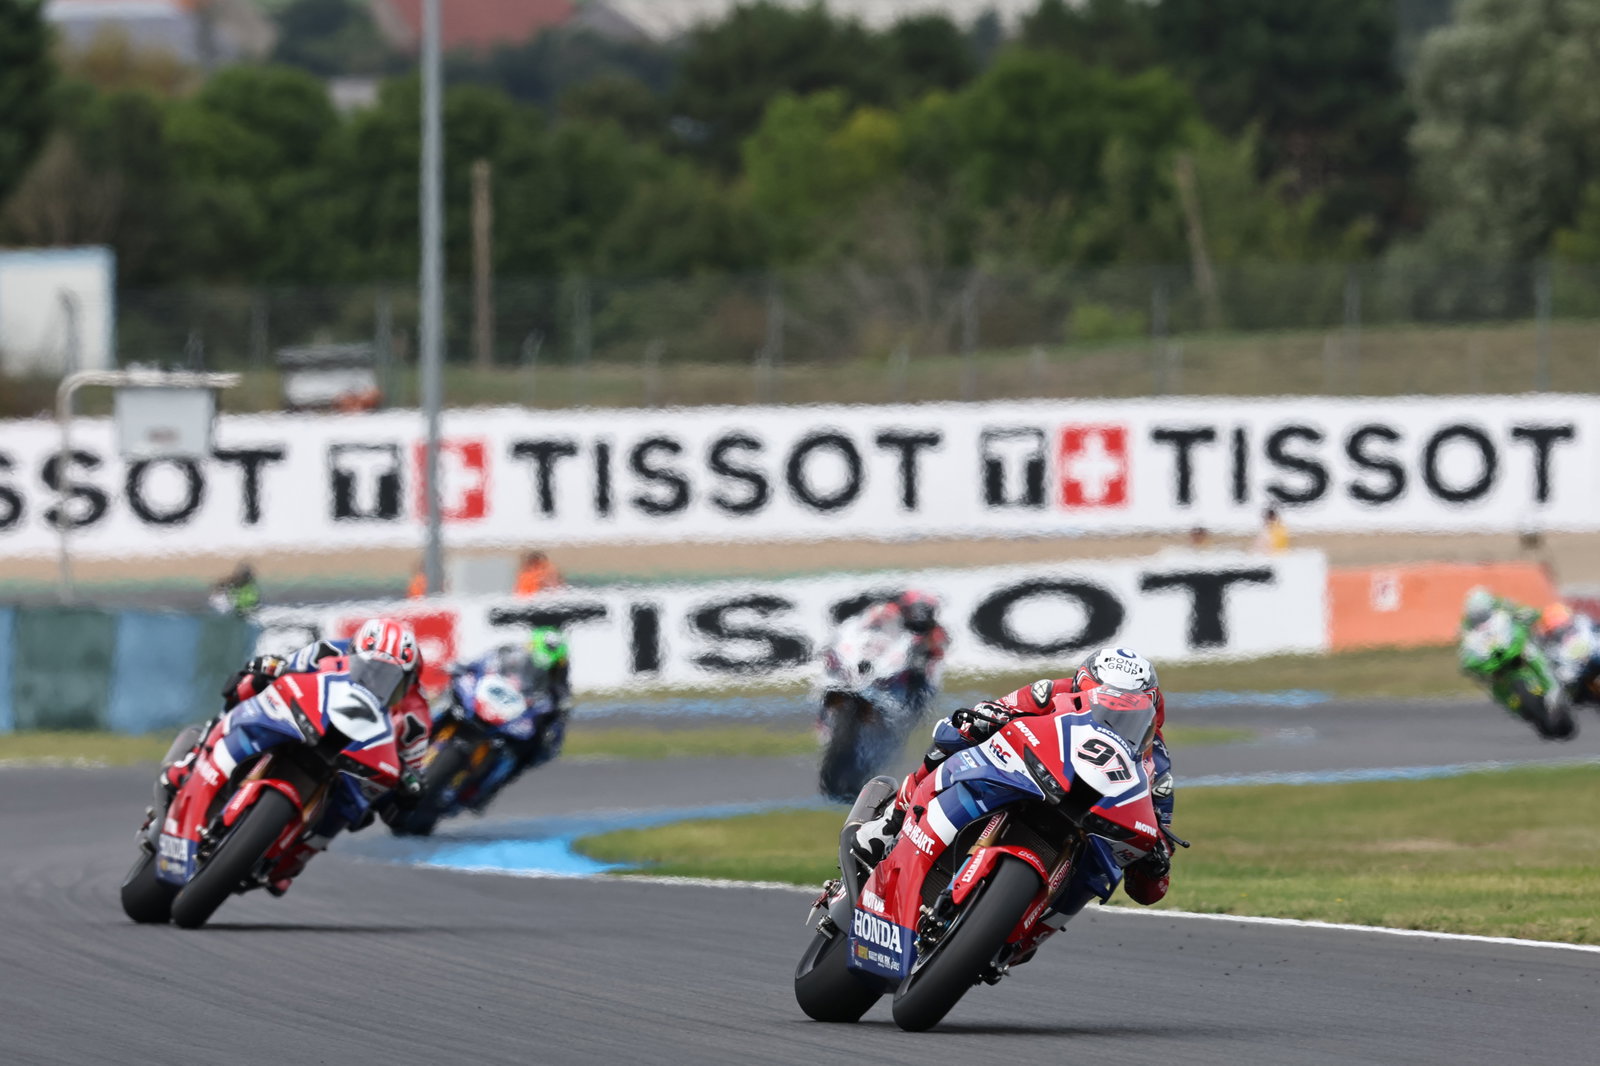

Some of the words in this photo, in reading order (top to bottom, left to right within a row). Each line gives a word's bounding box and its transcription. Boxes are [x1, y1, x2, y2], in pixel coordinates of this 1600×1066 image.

[511, 429, 941, 518] TISSOT
[1152, 423, 1575, 506] TISSOT
[1107, 662, 1138, 676] GRUP
[1108, 656, 1140, 670] PONT
[332, 692, 379, 724] 7
[1012, 720, 1041, 747] MOTUL
[1096, 726, 1132, 756] HONDA
[1077, 738, 1134, 783] 97
[1134, 820, 1157, 838] MOTUL
[854, 908, 903, 954] HONDA
